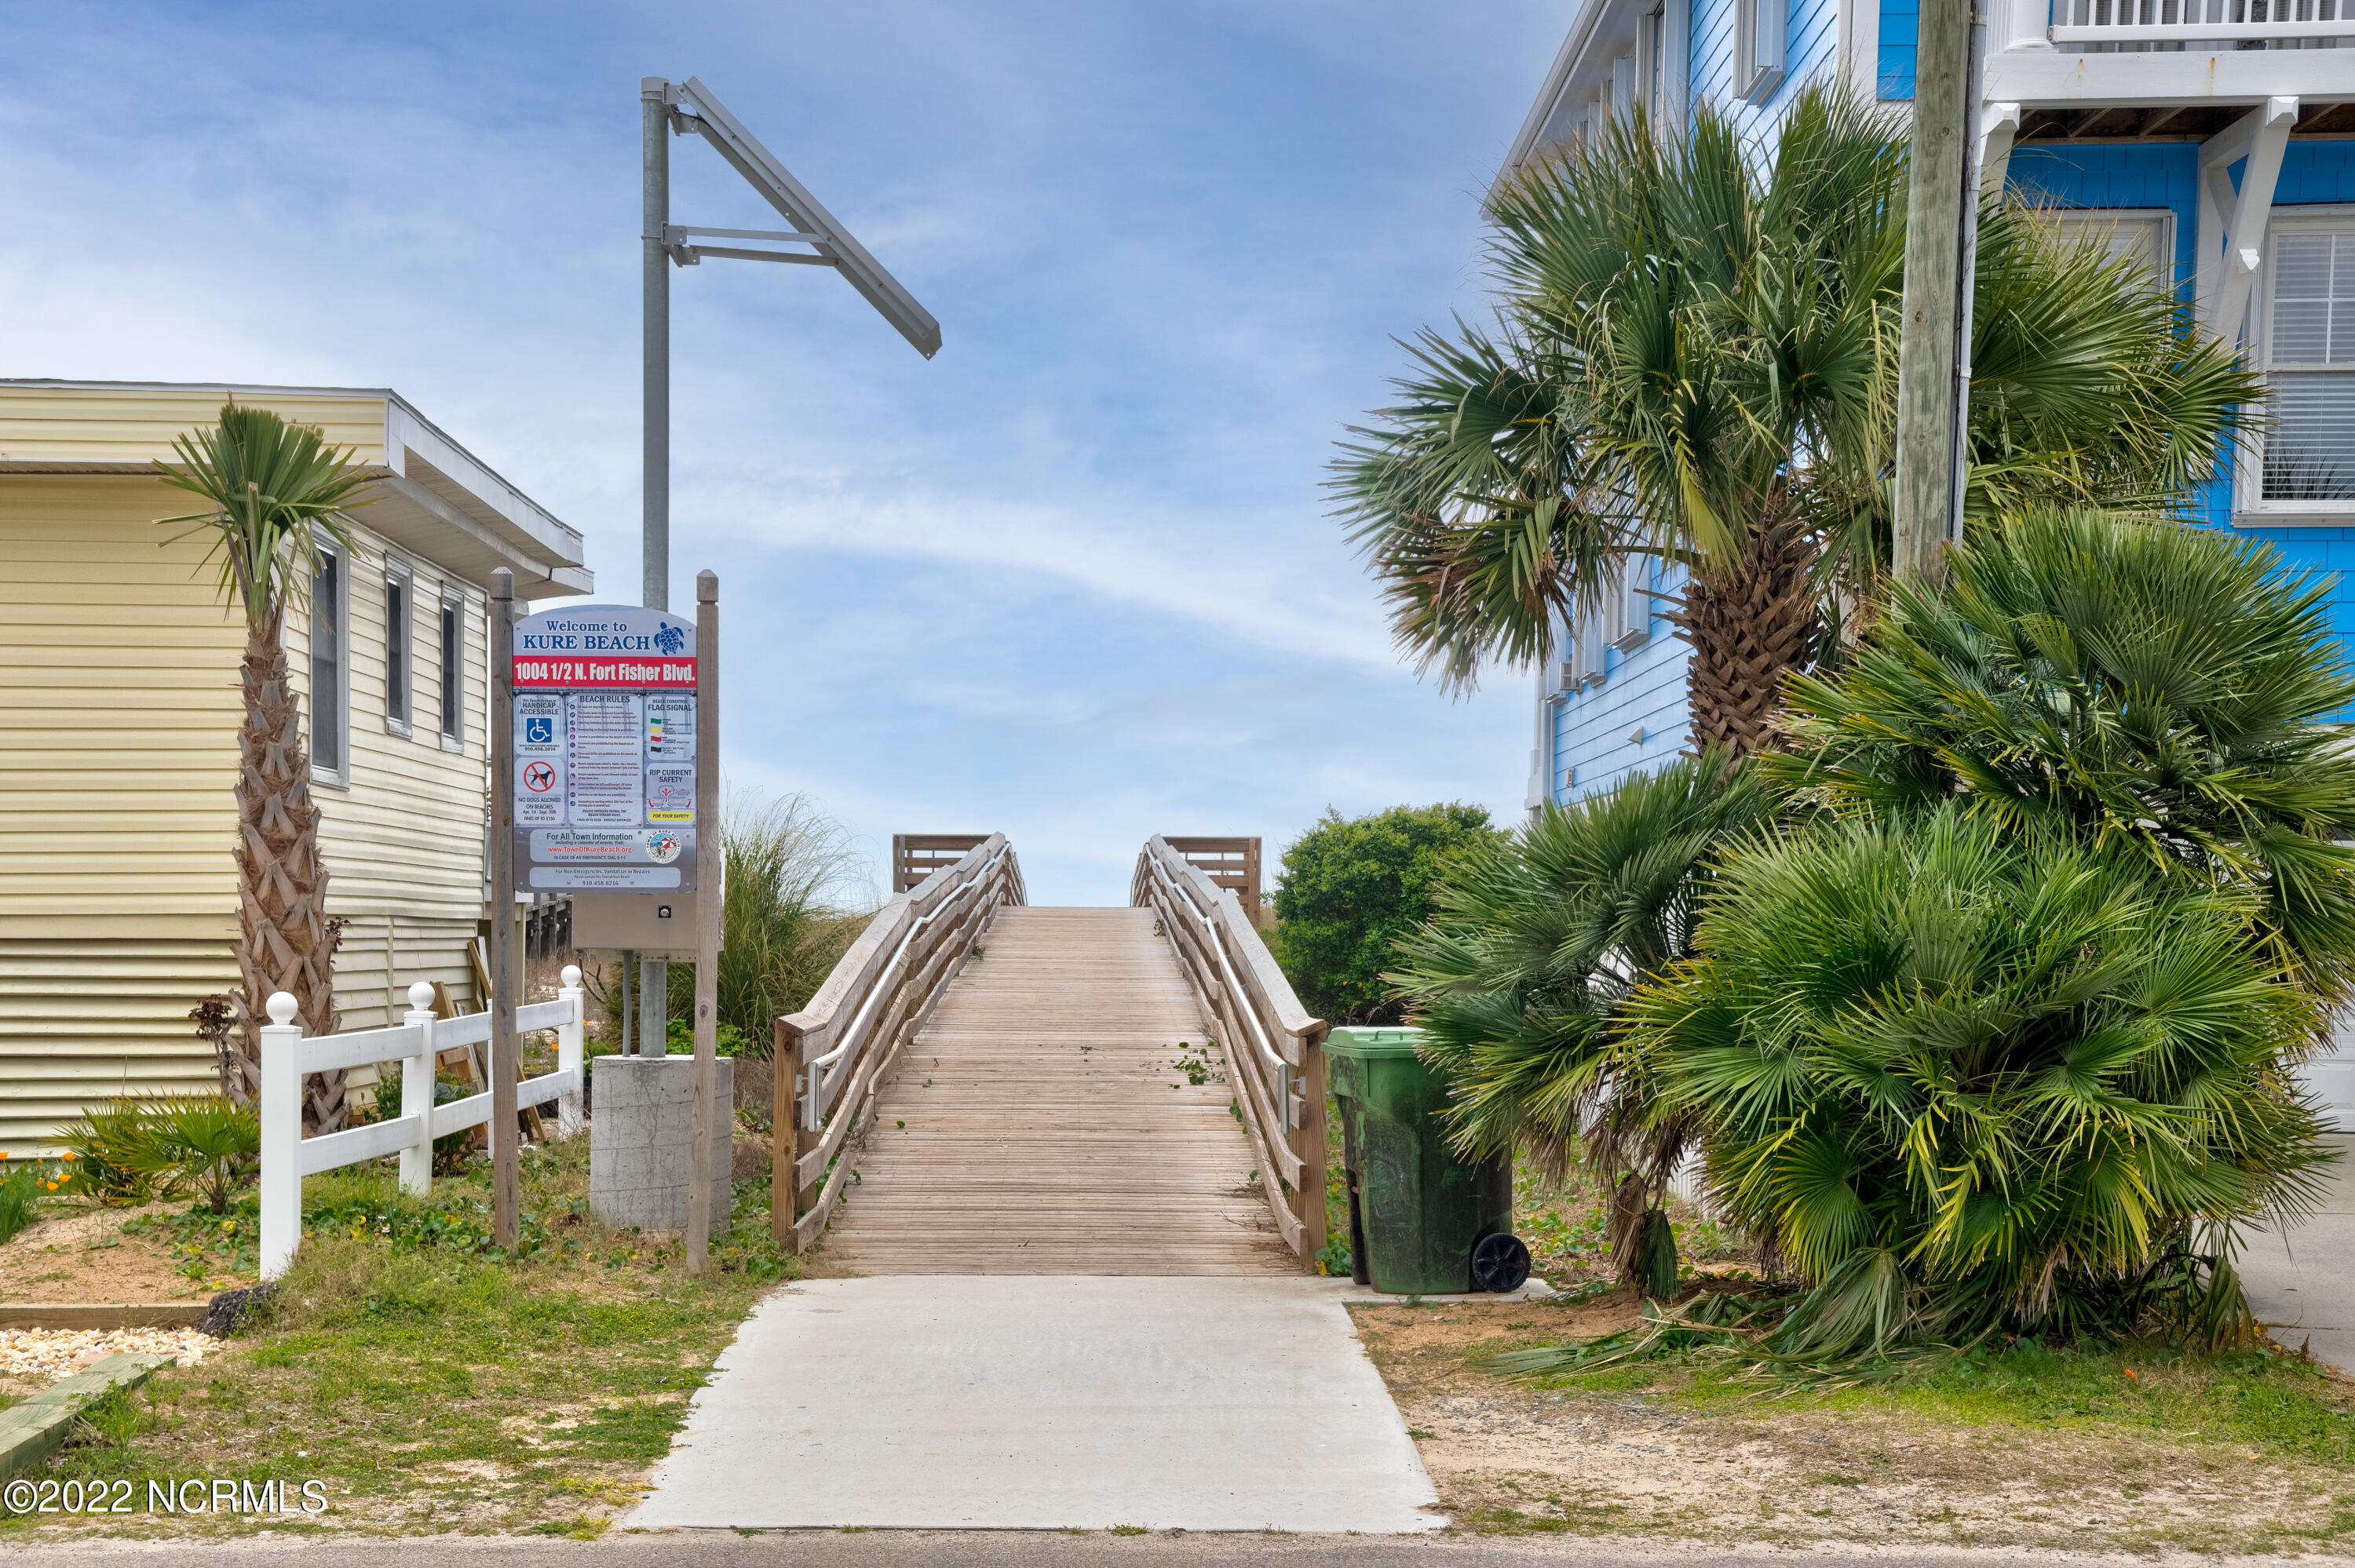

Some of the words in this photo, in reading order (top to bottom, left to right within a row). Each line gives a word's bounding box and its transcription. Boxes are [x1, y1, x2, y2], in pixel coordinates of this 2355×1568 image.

[546, 620, 608, 632] Welcome
[613, 620, 627, 632] to
[523, 634, 578, 650] KURE
[584, 634, 651, 650] BEACH
[515, 662, 548, 680] 1004
[550, 662, 572, 680] 1/2
[575, 663, 587, 680] N.
[590, 663, 616, 680] Fort
[619, 663, 660, 681] Fisher
[663, 664, 696, 681] Blvd.
